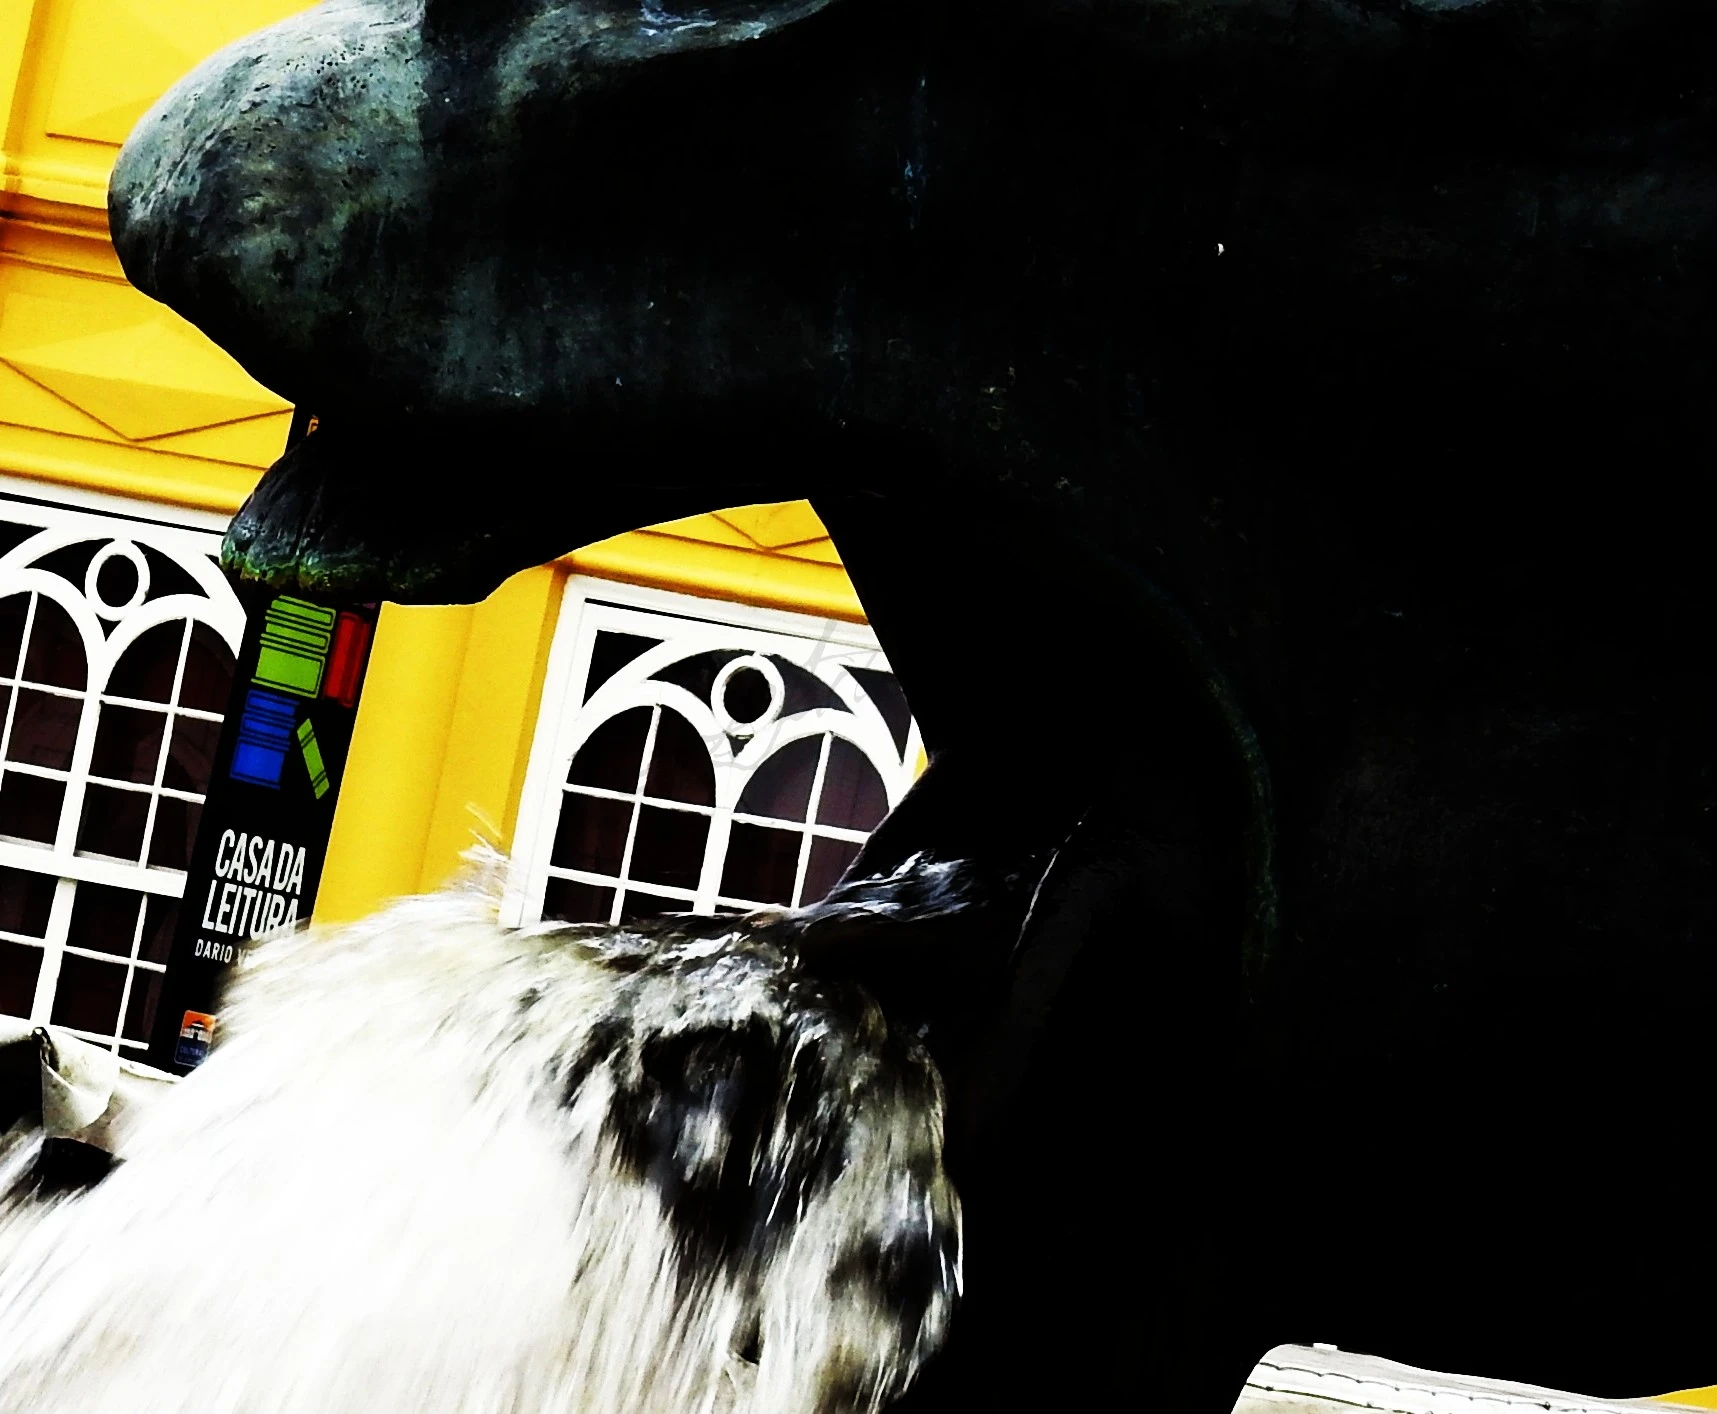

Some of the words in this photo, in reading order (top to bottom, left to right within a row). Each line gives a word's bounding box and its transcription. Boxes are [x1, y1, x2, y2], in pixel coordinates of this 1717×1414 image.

[215, 828, 275, 888] CASA
[273, 842, 306, 896] DA
[201, 879, 299, 941] LEITURA
[194, 938, 233, 964] DARIO
